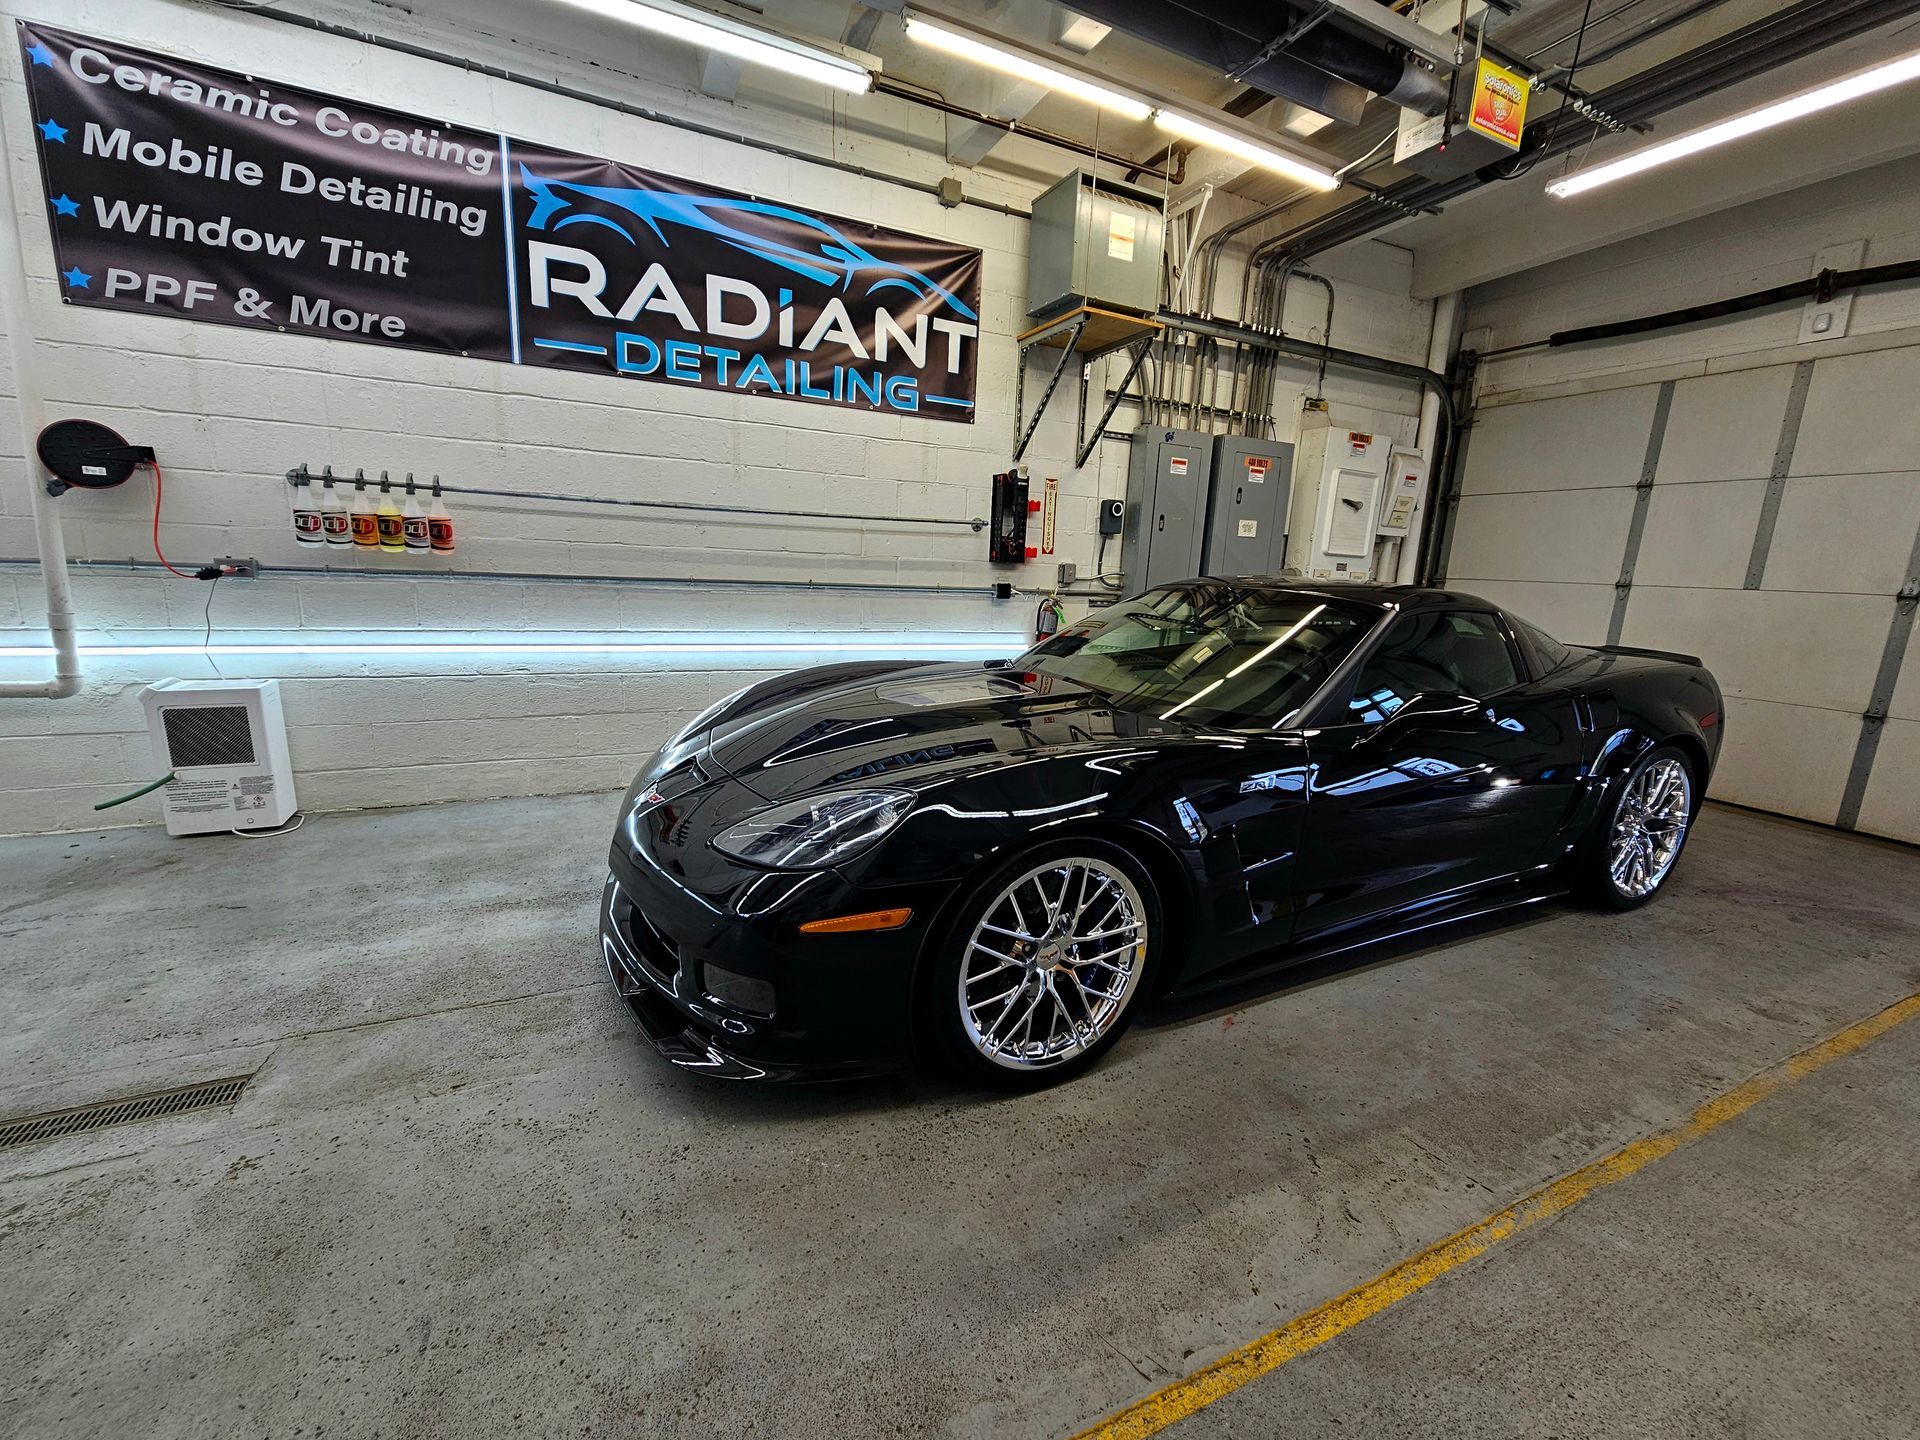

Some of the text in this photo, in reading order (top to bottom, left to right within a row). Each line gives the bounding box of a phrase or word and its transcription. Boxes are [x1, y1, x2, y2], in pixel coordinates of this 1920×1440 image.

[69, 47, 494, 177] Ceramic Coating
[82, 122, 488, 237] Mobile Detailing
[93, 195, 409, 278] Window Tint
[105, 267, 406, 338] PPF & More
[615, 331, 919, 412] DETAILING
[1239, 774, 1277, 793] ZR1
